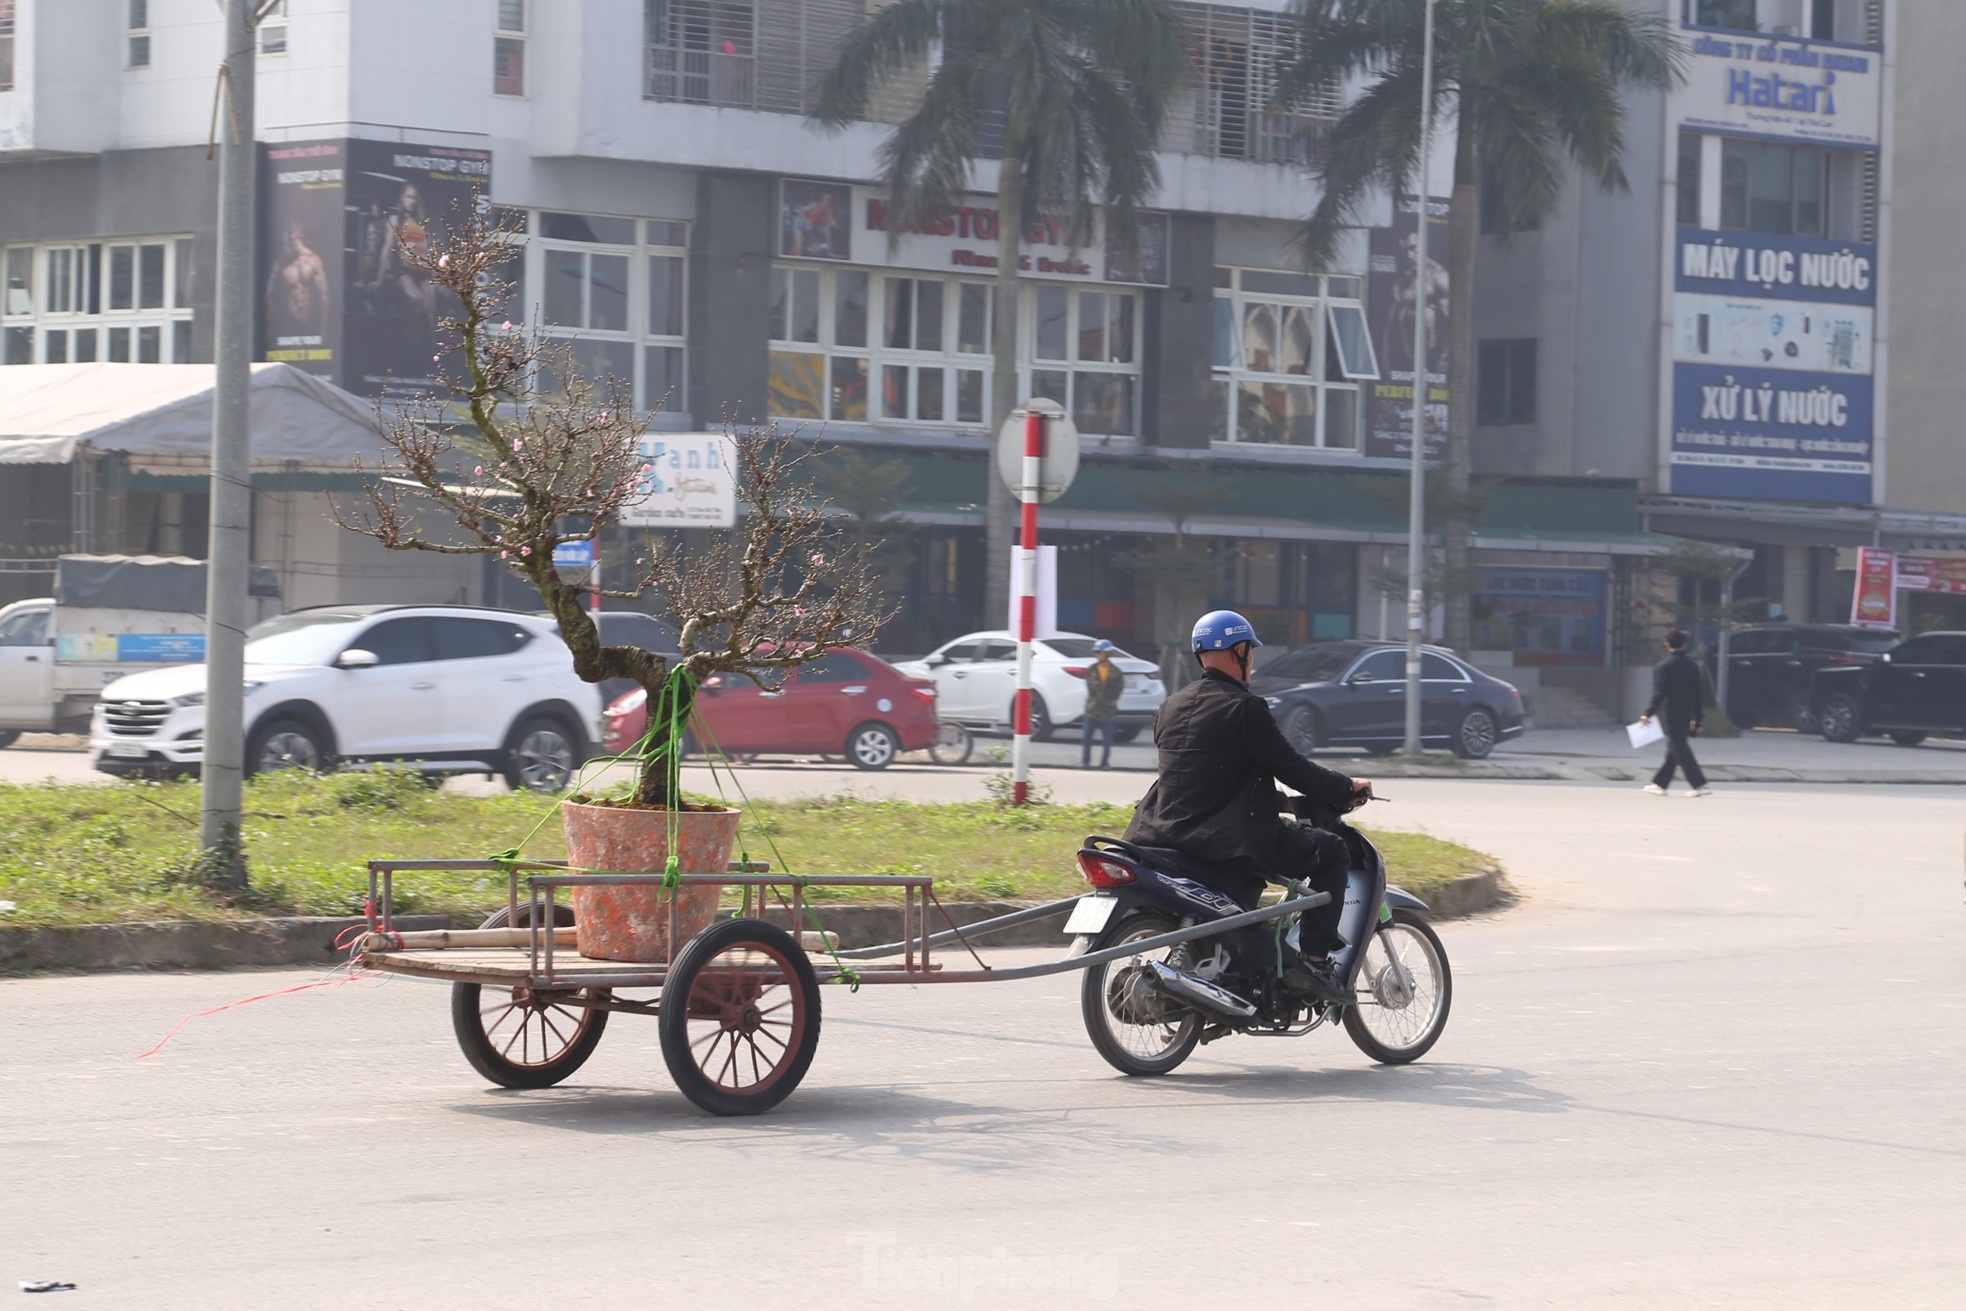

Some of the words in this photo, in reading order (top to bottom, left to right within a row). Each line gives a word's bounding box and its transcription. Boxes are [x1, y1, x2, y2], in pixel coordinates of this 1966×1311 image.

[1727, 69, 1837, 115] Hatari
[393, 154, 457, 172] NONSTOP
[1683, 238, 1739, 280] MÁY
[1745, 248, 1794, 290] LỌC
[1801, 248, 1869, 291] NƯỚC
[1702, 375, 1740, 421] XỬ
[1744, 382, 1773, 422] LÝ
[1778, 385, 1847, 426] NƯỚC
